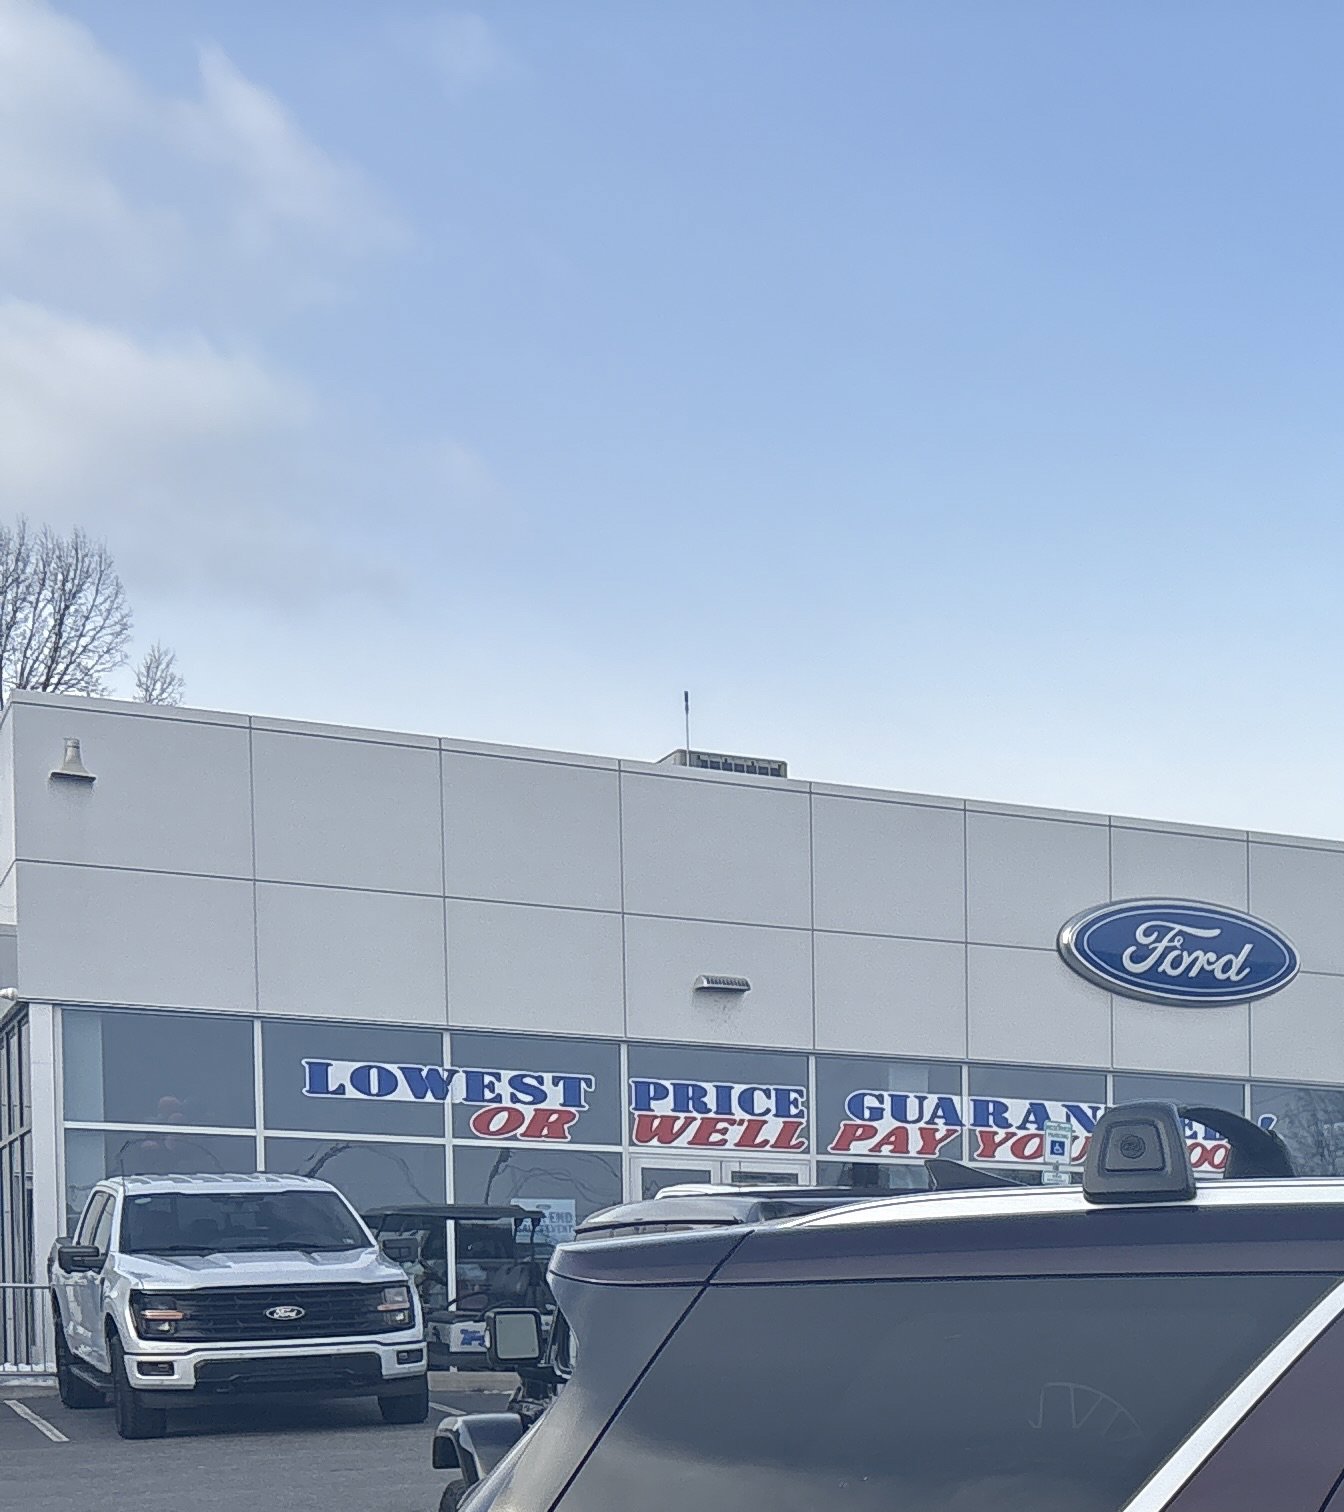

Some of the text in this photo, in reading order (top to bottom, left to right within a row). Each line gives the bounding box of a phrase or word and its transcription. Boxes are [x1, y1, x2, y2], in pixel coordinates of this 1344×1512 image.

[1122, 920, 1254, 982] Ford
[304, 1060, 593, 1109] LOWEST
[631, 1080, 805, 1119] PRICE
[471, 1105, 577, 1140] OR
[634, 1113, 806, 1150] WE'LL
[830, 1123, 960, 1156] PAY
